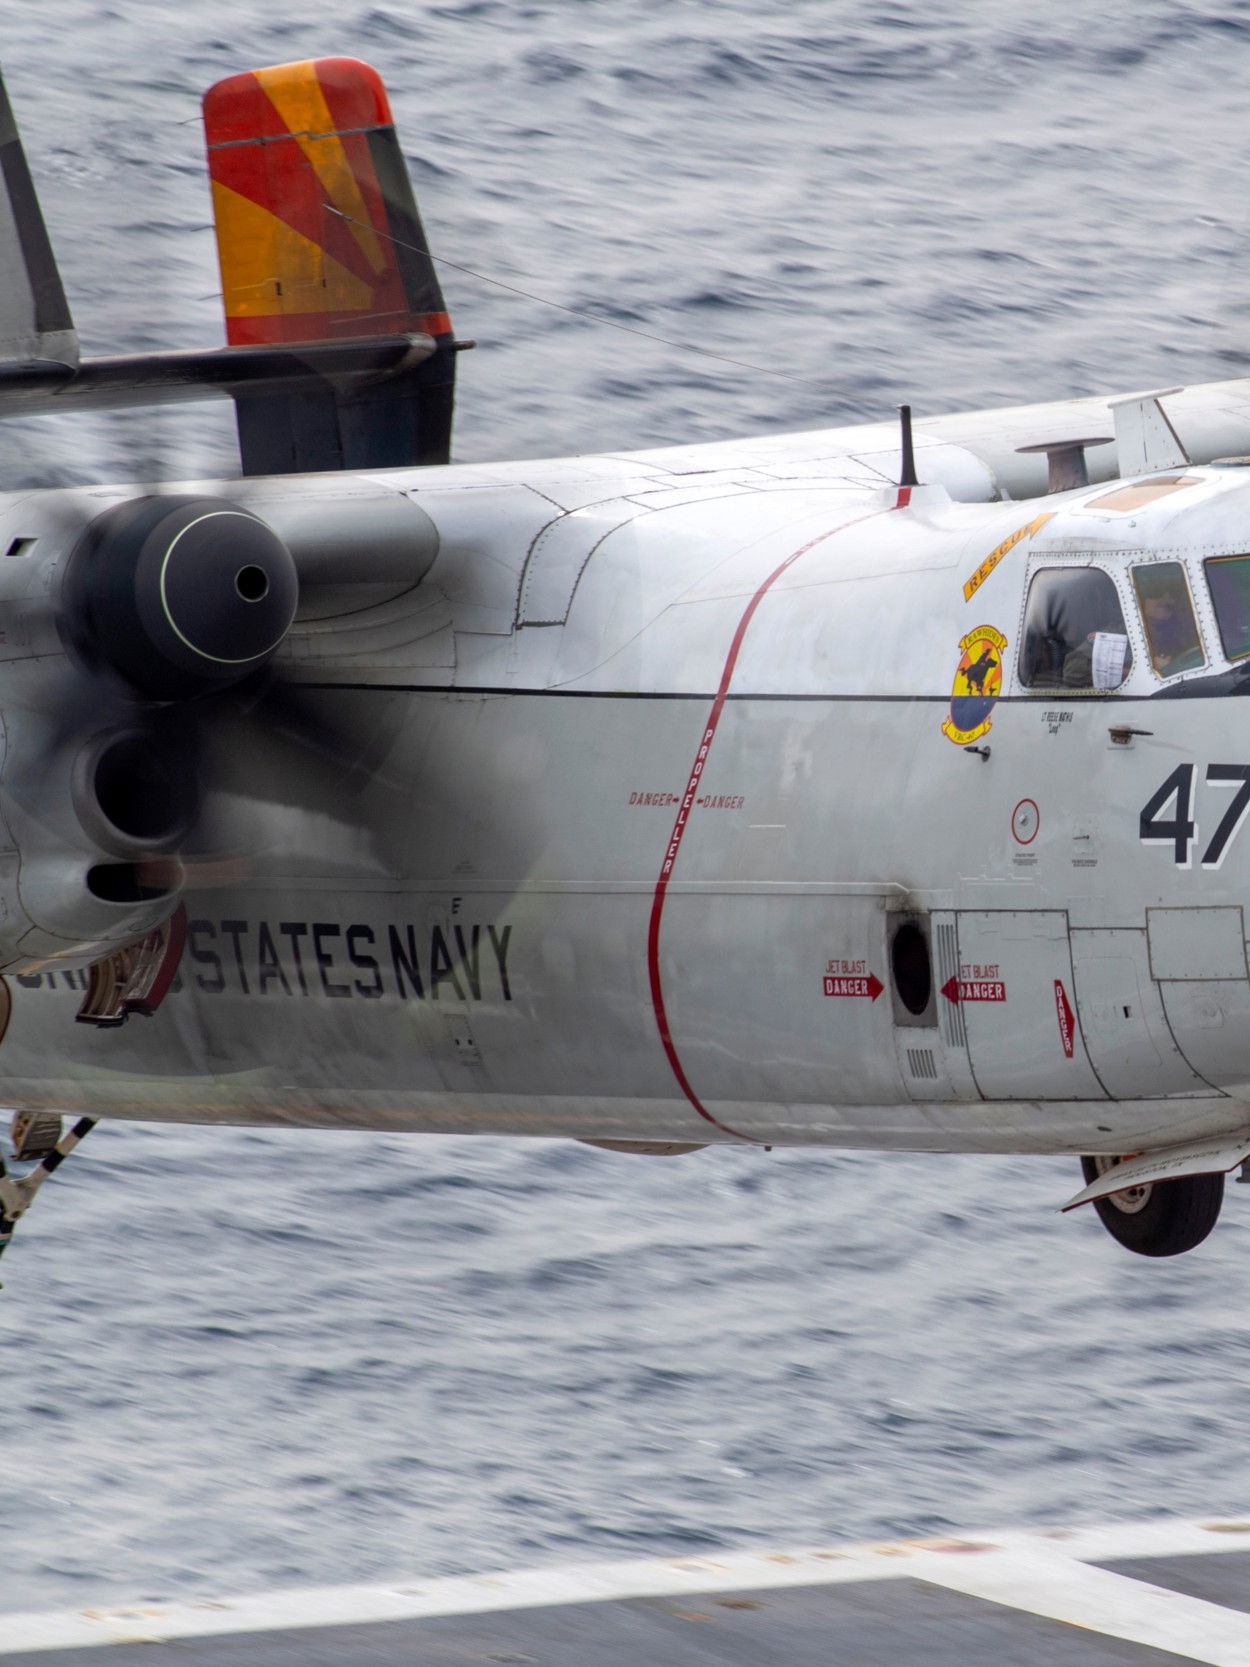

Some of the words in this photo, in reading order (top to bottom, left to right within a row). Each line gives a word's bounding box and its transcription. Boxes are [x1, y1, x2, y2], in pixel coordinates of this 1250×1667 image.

[969, 526, 1031, 592] RESCUE
[628, 792, 673, 807] DANGER
[663, 729, 713, 873] PROPELLER
[703, 795, 745, 809] DANGER
[190, 920, 383, 999] STATES
[388, 924, 512, 1001] NAVY
[825, 960, 840, 973] JET
[842, 960, 866, 973] BLAST
[974, 964, 999, 979] BLAST
[826, 979, 868, 994] DANGER
[1056, 986, 1071, 1051] DANGER
